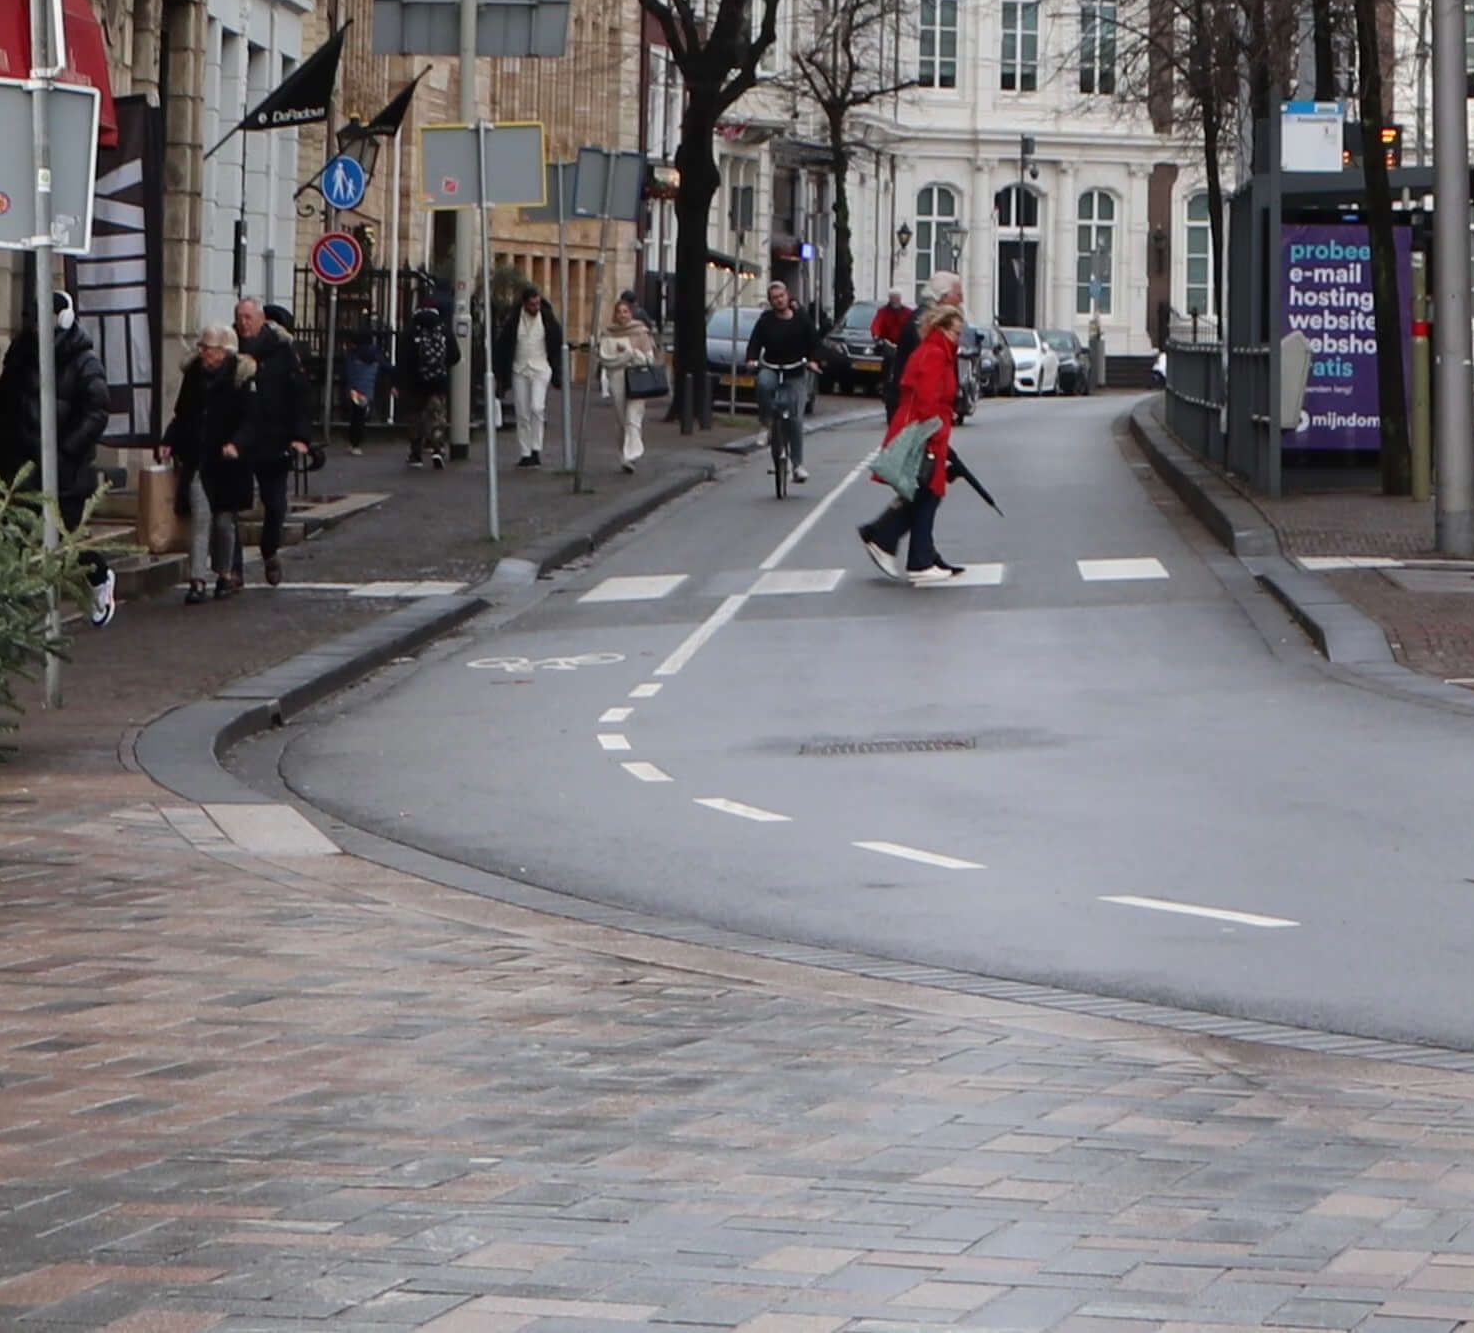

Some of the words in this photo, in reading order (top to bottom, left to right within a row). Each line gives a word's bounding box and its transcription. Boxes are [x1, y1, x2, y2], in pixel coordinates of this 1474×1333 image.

[1290, 239, 1371, 263] probee
[1289, 263, 1362, 284] e-mail
[1289, 285, 1375, 312] hosting
[1310, 333, 1378, 354] ebsho
[1310, 356, 1354, 377] atis
[1311, 411, 1381, 431] mijndom
